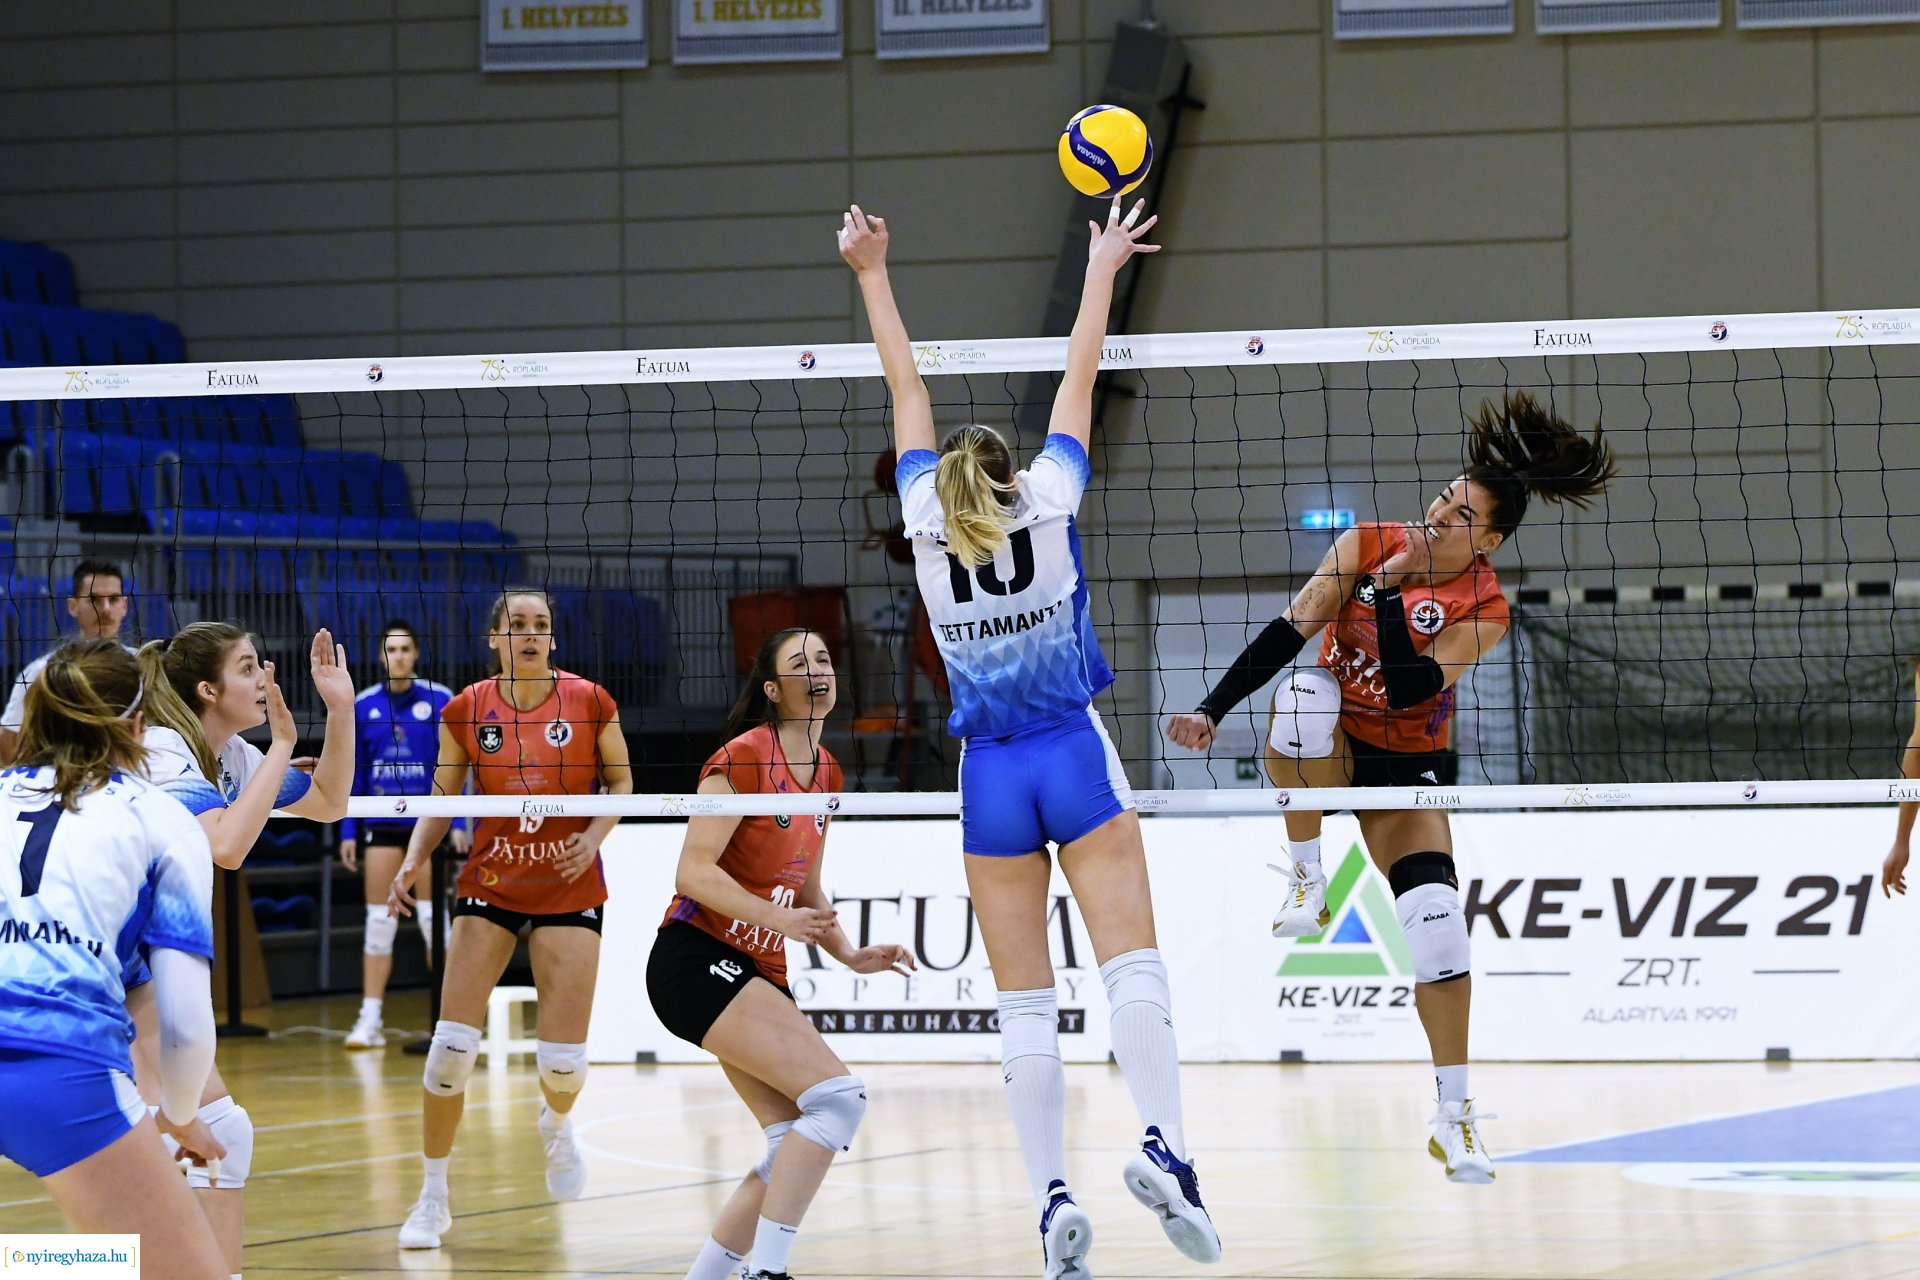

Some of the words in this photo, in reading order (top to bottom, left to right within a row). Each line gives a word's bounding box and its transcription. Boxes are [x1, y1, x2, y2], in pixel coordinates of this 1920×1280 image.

[1533, 328, 1593, 346] FATUM
[1099, 347, 1133, 361] TUM
[636, 357, 691, 374] FATUM
[206, 369, 260, 386] FATUM
[522, 800, 565, 814] FATUM
[1414, 791, 1461, 806] FATUM
[1463, 876, 1759, 939] KE-VIZ
[1776, 874, 1874, 936] 21
[1617, 958, 1702, 987] ZRT.
[1278, 986, 1382, 1007] KE-VIZ
[1695, 1006, 1738, 1022] 1991
